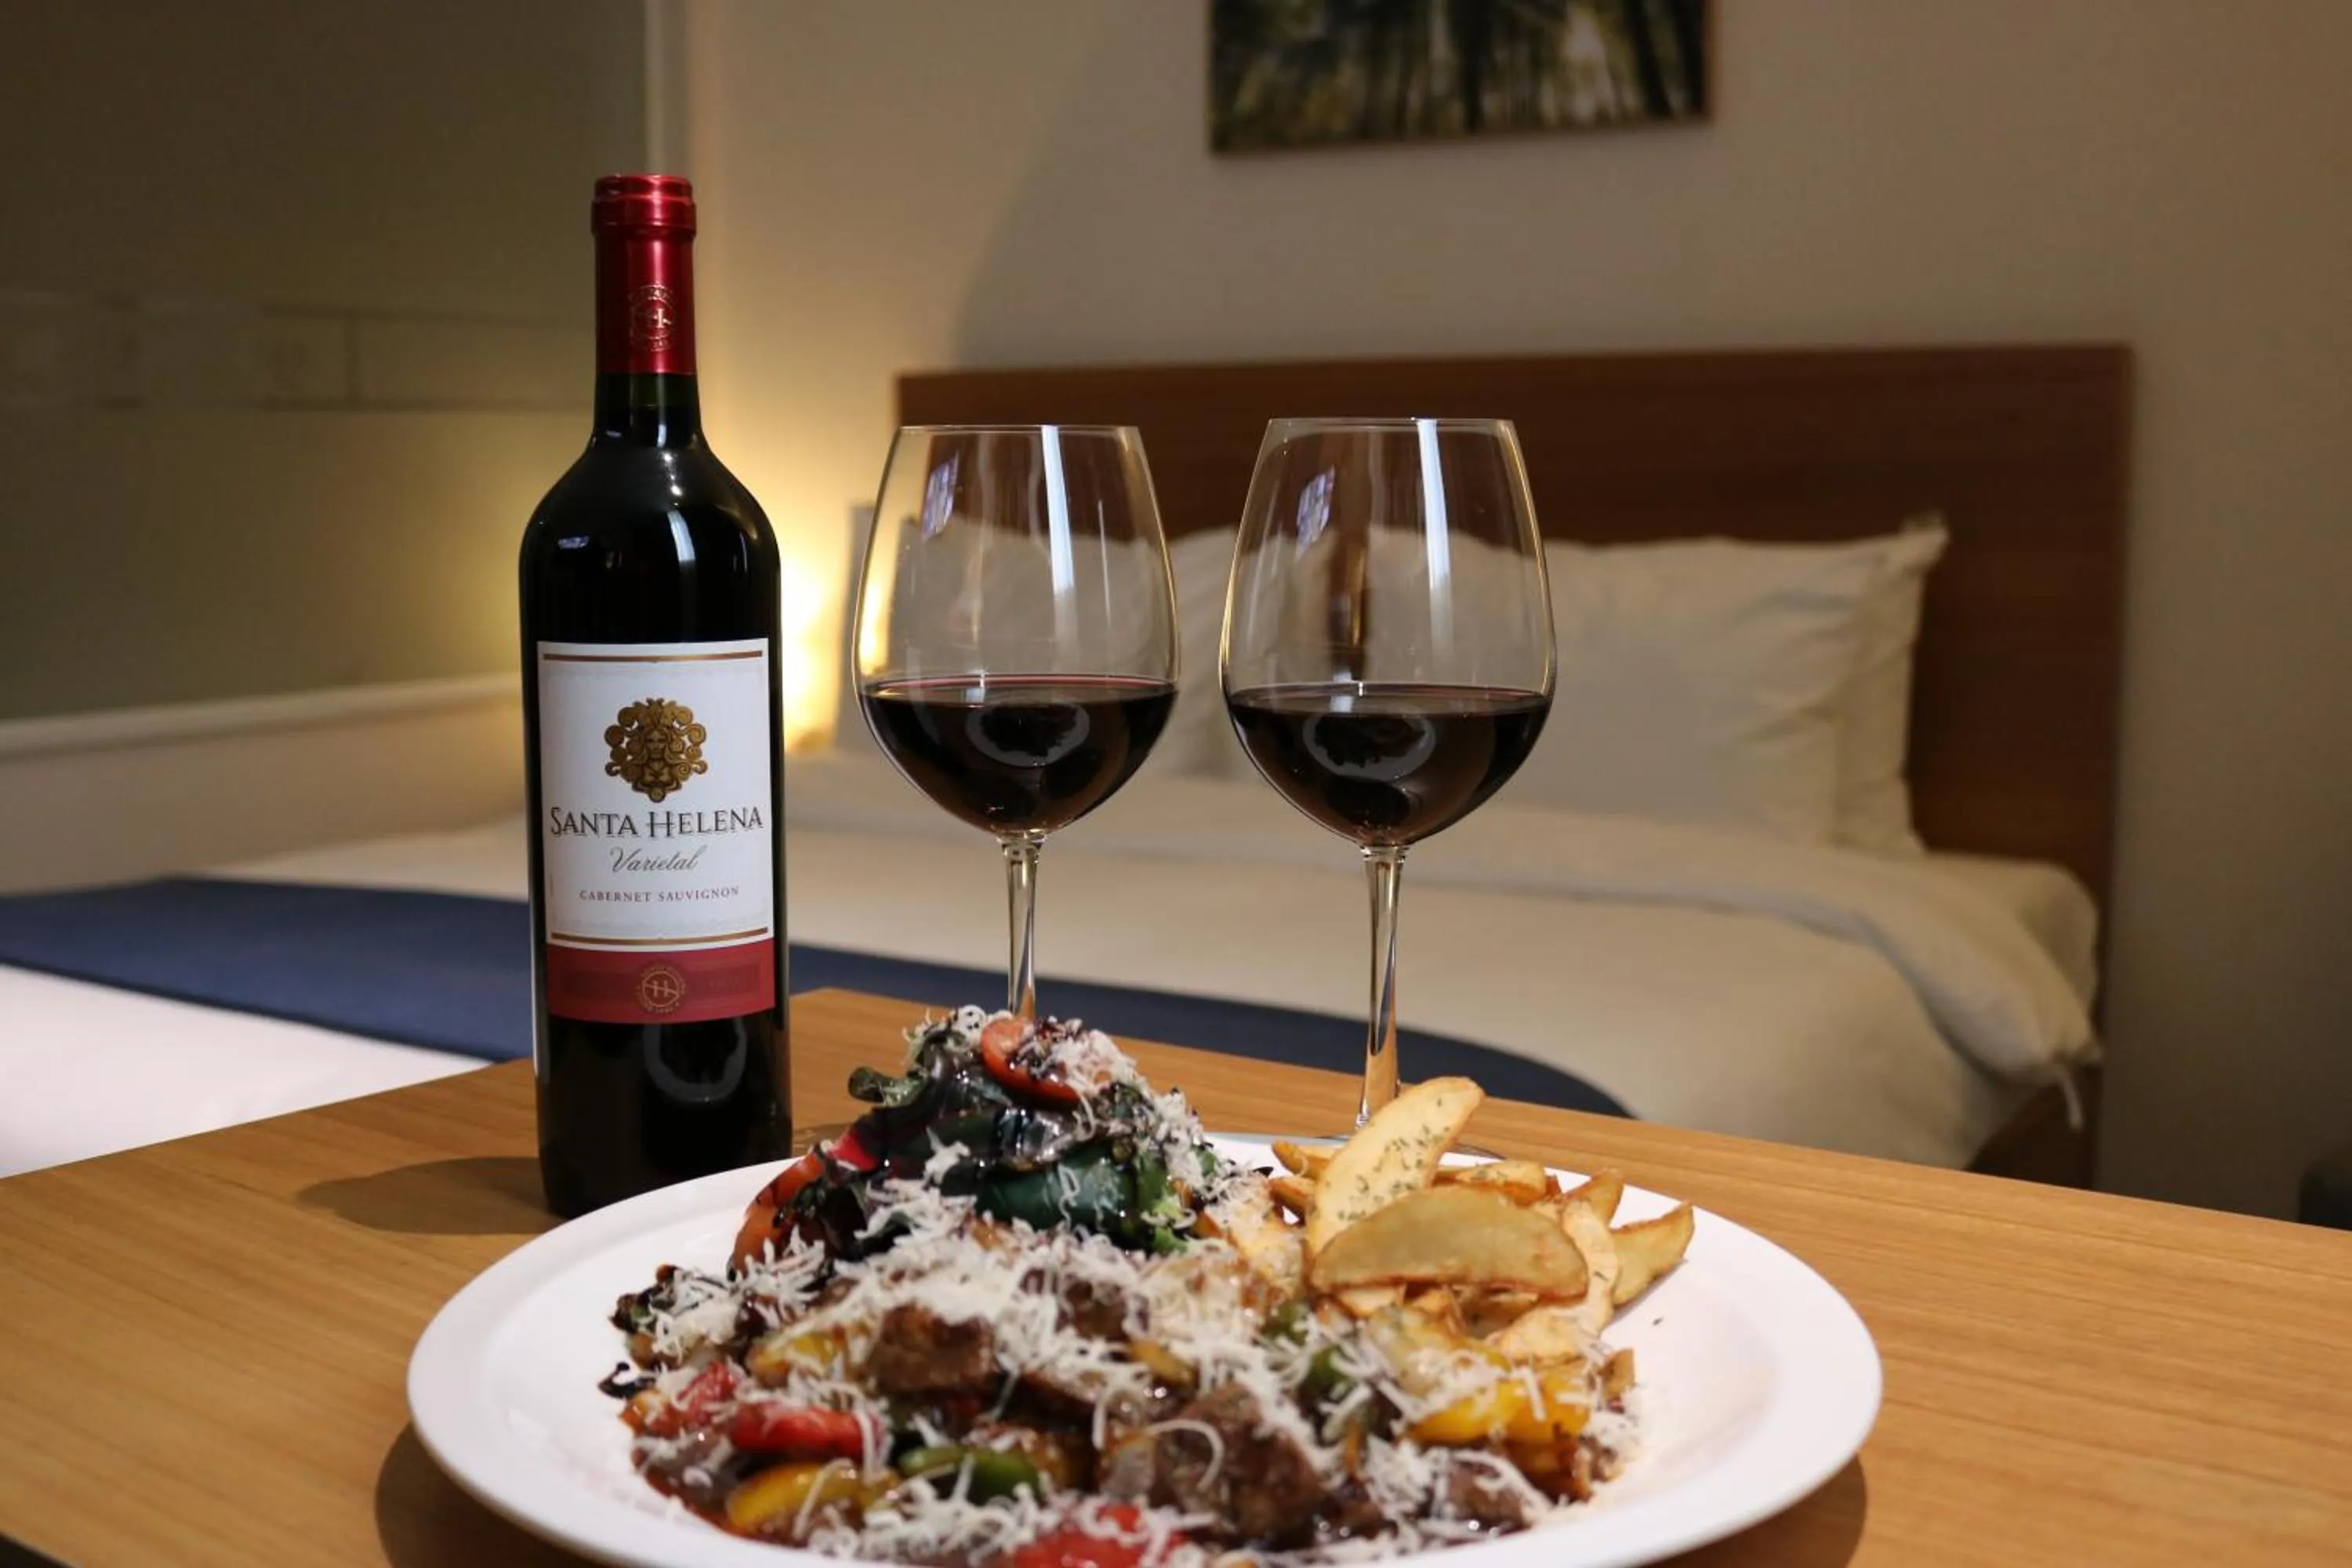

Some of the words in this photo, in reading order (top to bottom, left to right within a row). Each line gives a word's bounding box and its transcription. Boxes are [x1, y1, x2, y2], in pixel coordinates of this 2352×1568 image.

[550, 807, 639, 837] SANTA
[647, 806, 764, 837] HELENA
[609, 844, 707, 873] Varietal
[579, 889, 652, 902] CABERNET
[658, 886, 739, 902] SAUVIGNON
